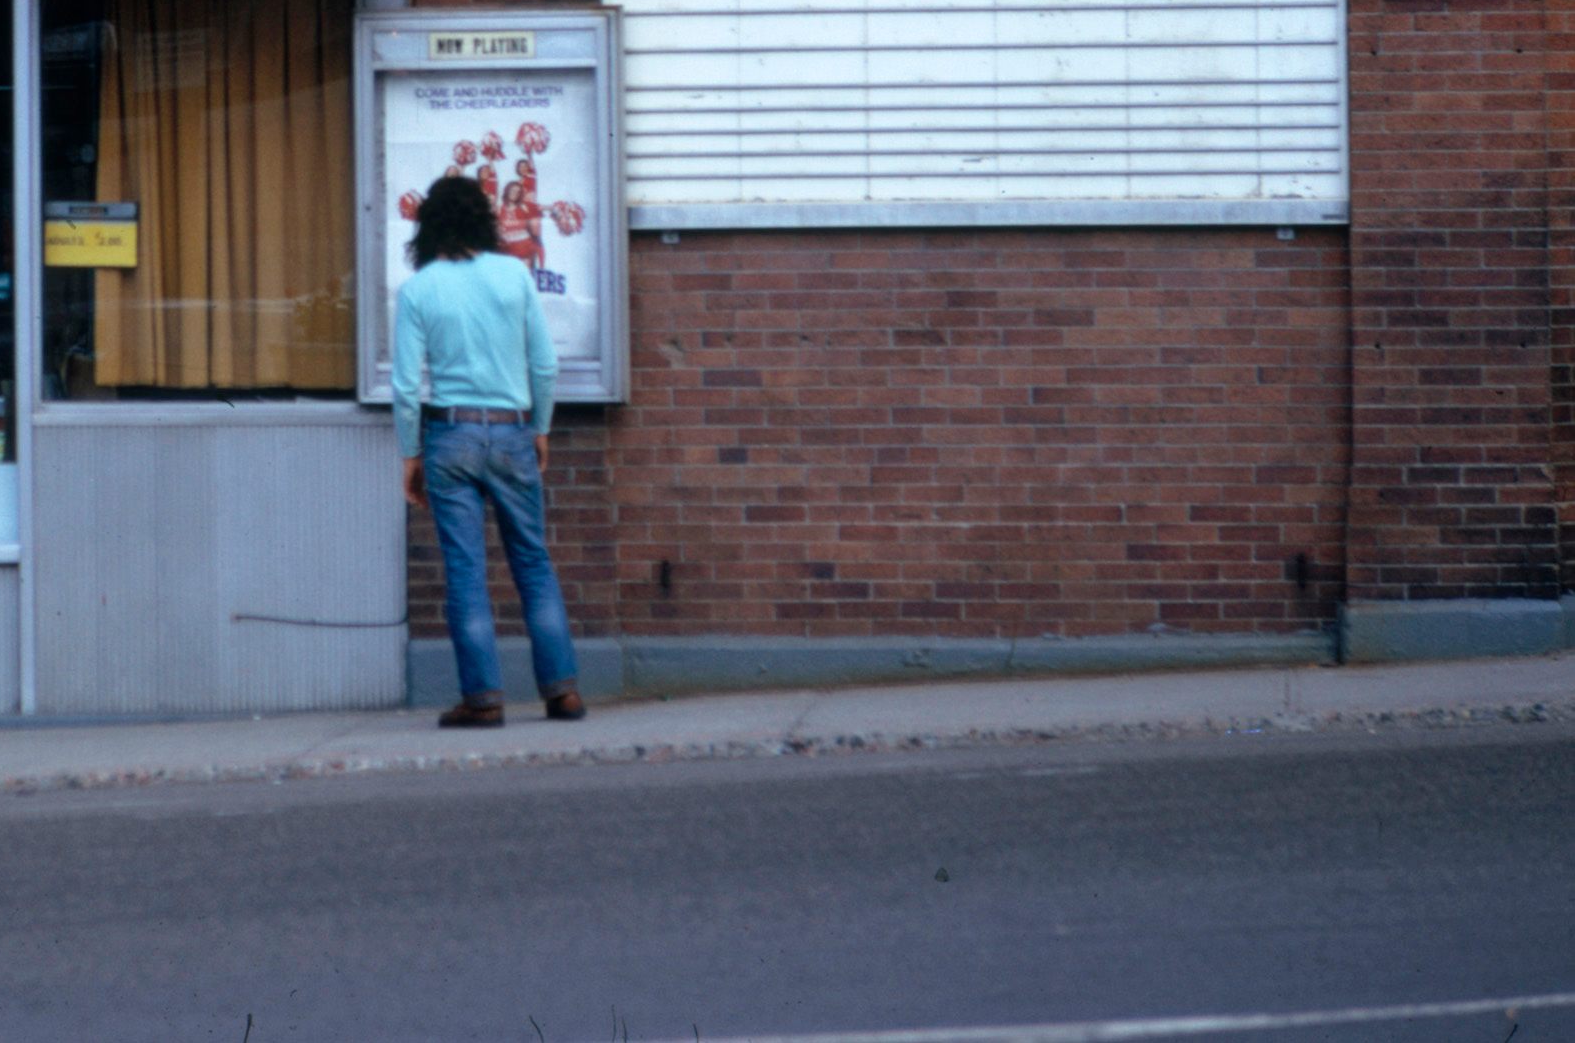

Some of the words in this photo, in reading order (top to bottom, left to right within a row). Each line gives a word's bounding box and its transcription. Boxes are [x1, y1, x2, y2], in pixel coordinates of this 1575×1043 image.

[436, 38, 463, 54] NOW
[473, 37, 528, 54] PLAYING
[414, 86, 449, 99] COME
[453, 86, 478, 98] AND
[480, 85, 527, 98] HUDDLE
[532, 85, 564, 97] WITH
[429, 98, 451, 110] THE
[454, 97, 551, 109] CHEERLEADERS
